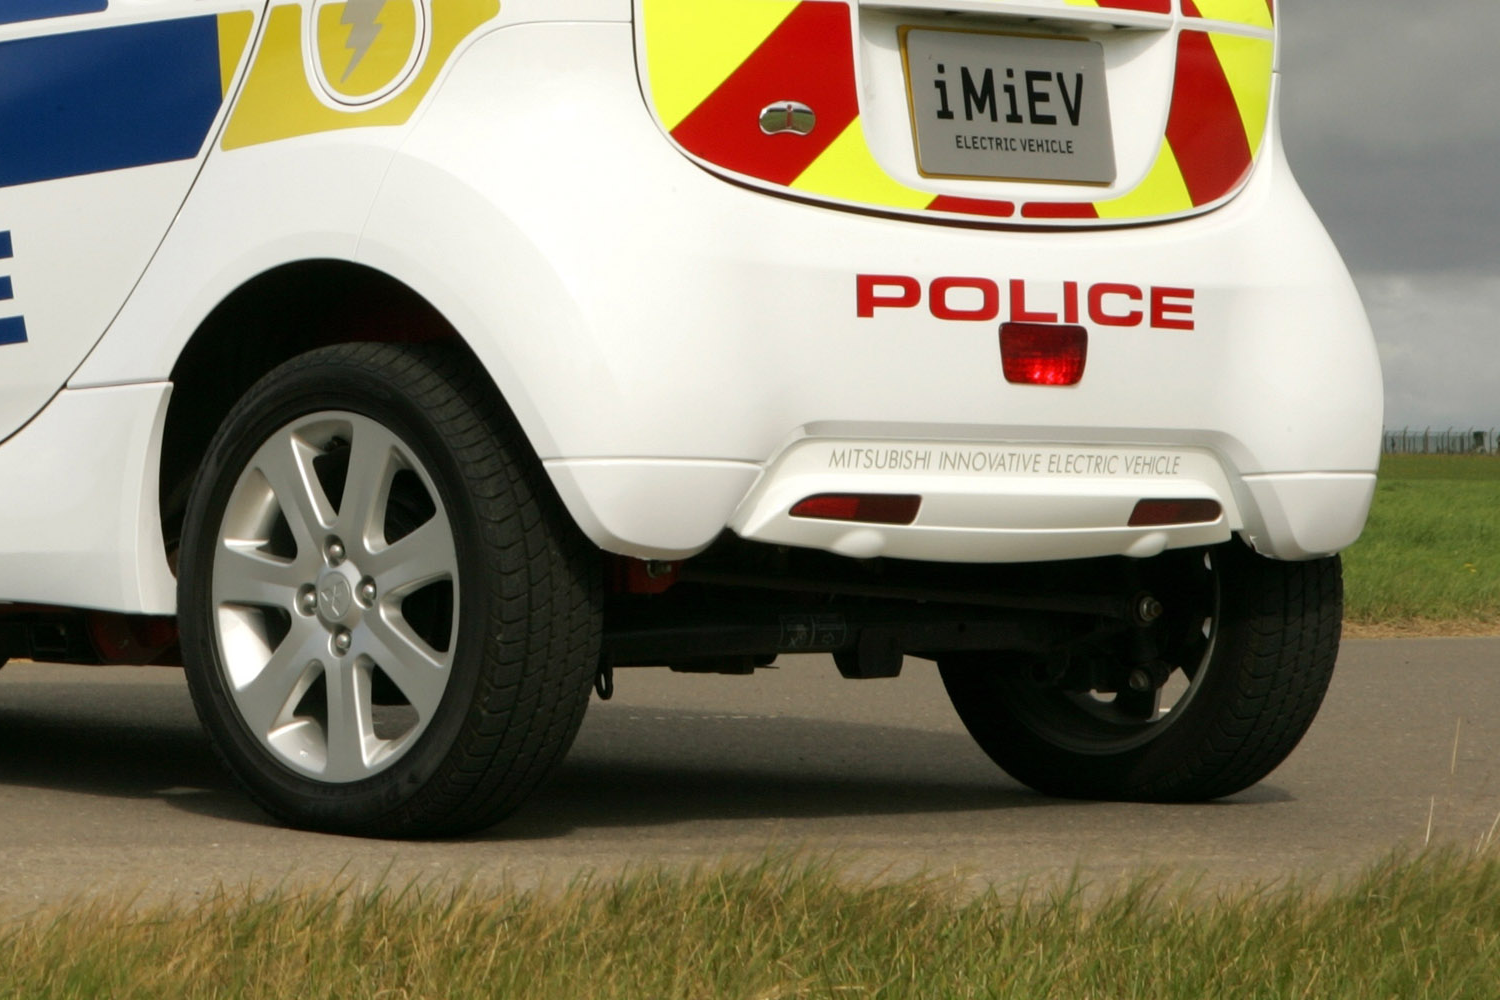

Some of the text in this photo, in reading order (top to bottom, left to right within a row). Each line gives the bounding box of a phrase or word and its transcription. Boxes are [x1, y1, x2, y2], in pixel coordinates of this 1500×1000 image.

[955, 134, 1074, 154] ELECTRIC VEHICLE
[855, 273, 1195, 331] POLICE
[828, 448, 1181, 476] MITSUBISHI INNOVATIVE ELECTRIC VEHICLE
